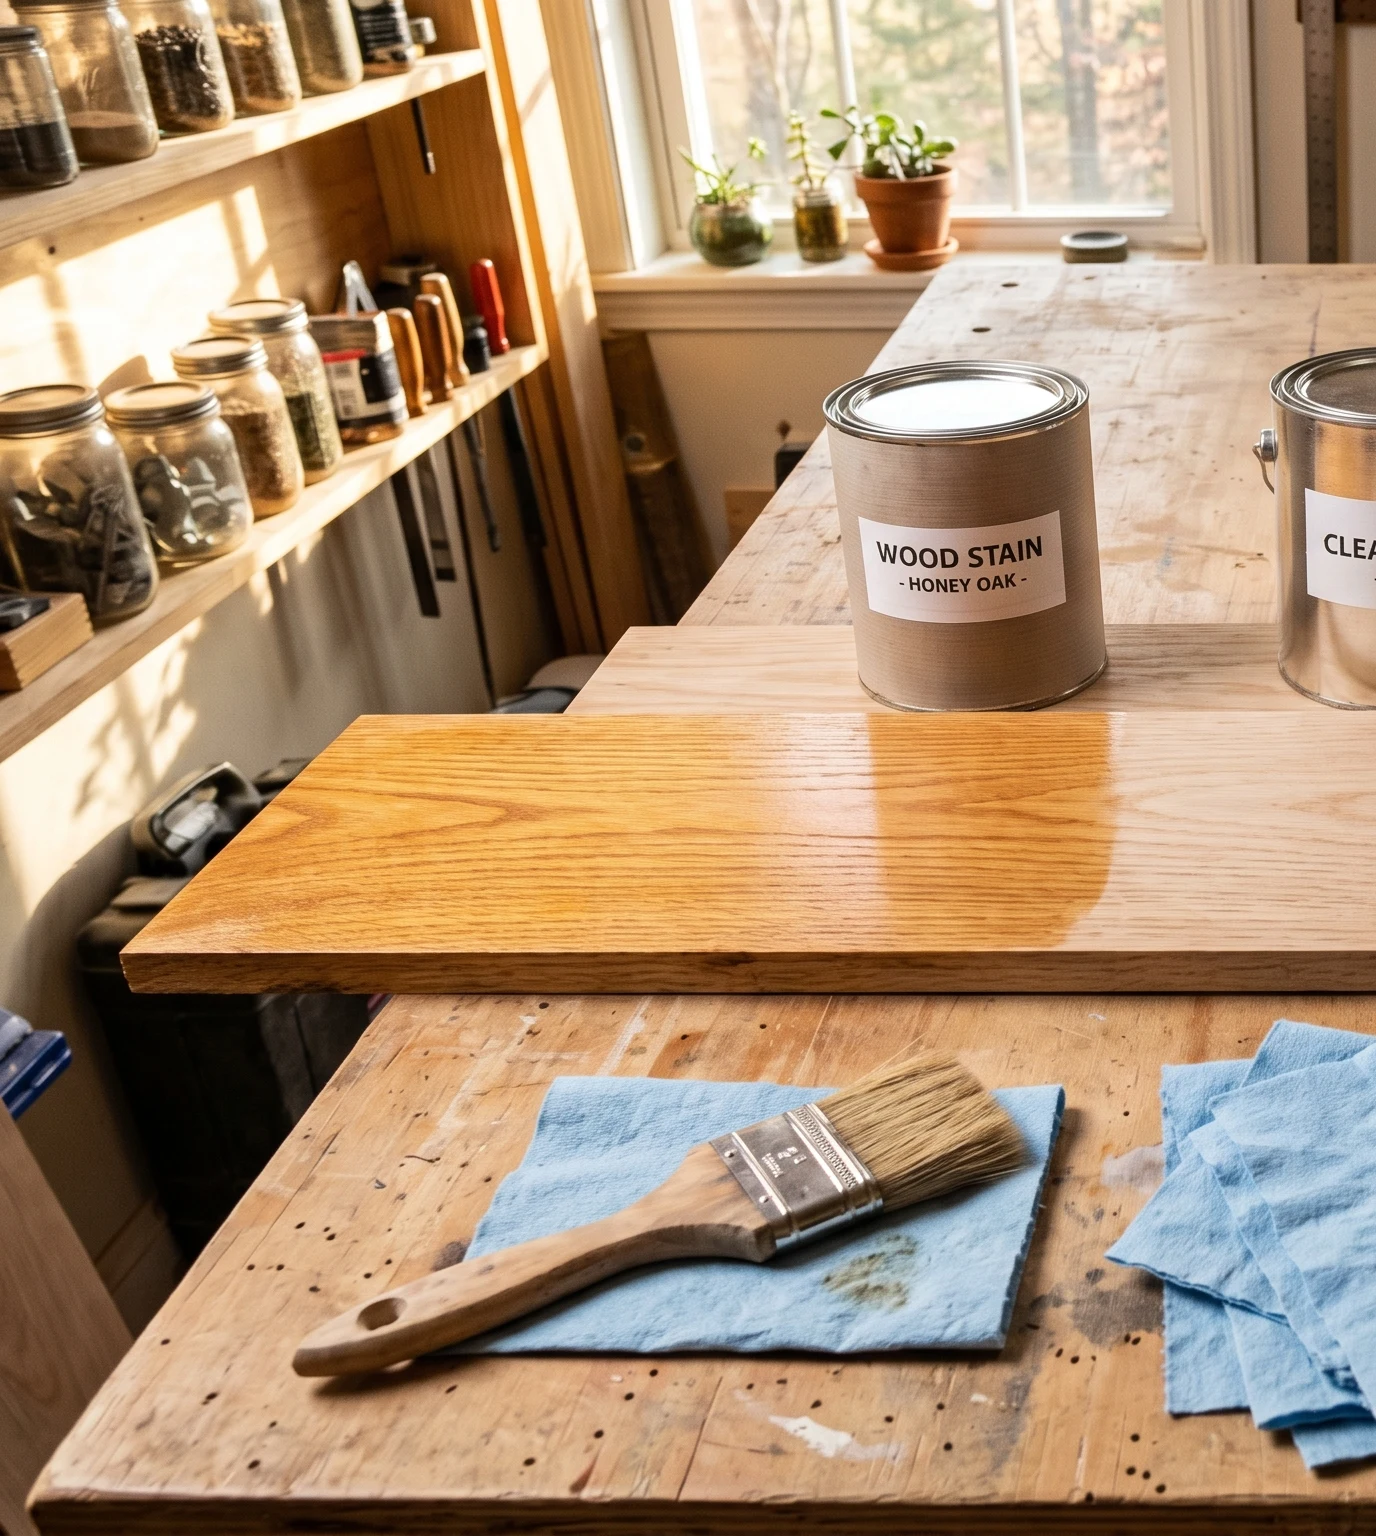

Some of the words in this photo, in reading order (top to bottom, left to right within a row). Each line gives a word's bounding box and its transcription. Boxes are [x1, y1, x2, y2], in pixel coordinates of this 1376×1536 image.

[876, 540, 959, 569] WOOD
[968, 535, 1043, 568] STAIN
[908, 576, 971, 593] HONEY
[976, 573, 1017, 592] OAK
